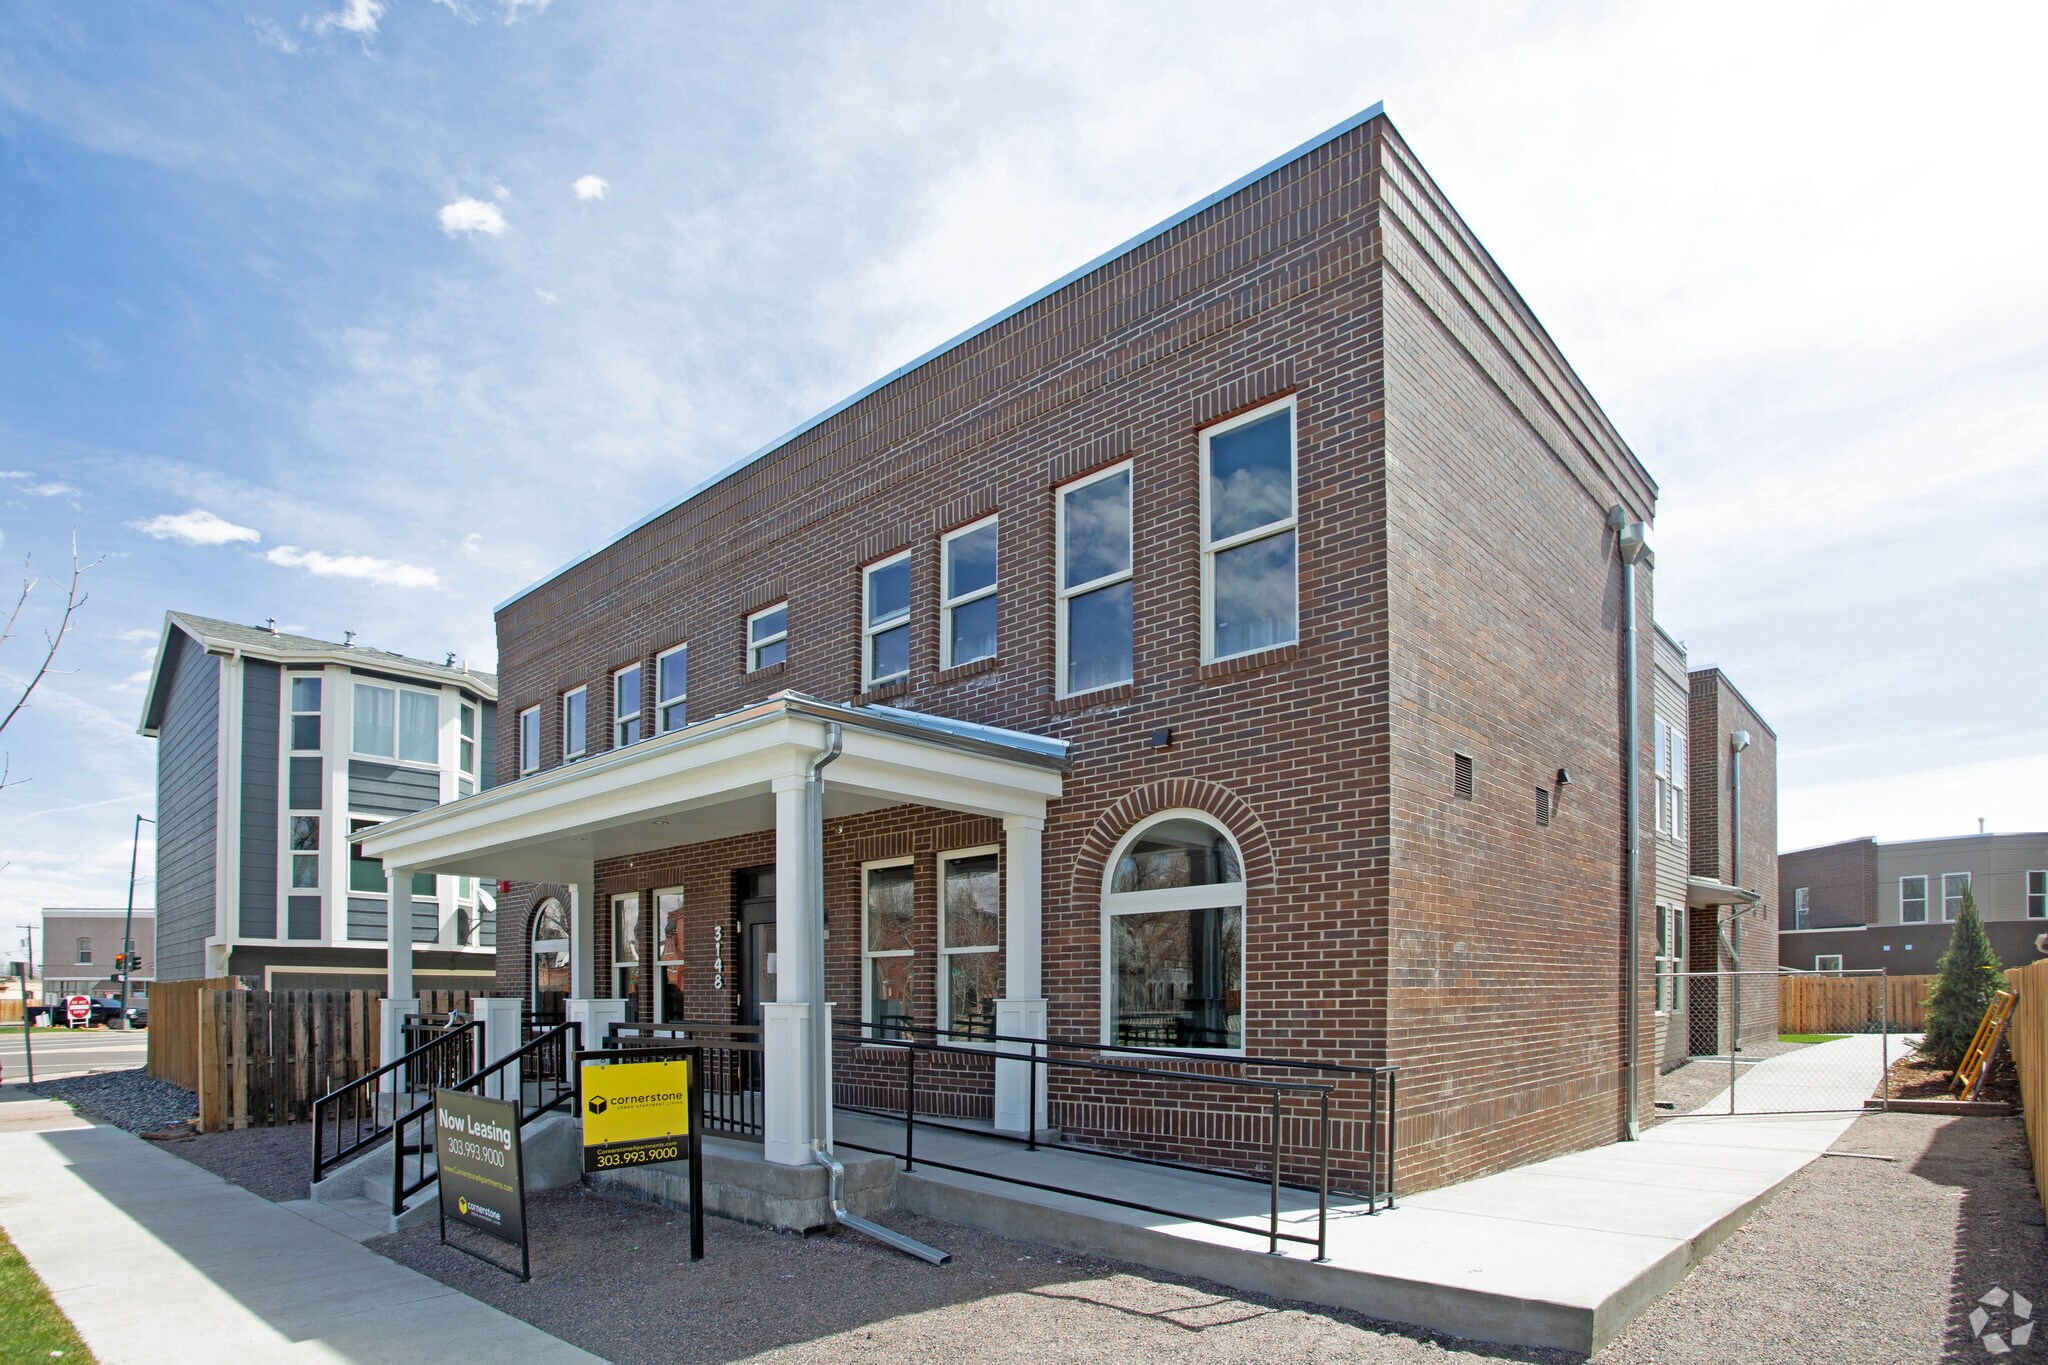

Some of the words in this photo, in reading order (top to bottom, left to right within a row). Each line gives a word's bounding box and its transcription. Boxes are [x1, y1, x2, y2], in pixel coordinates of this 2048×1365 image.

[714, 925, 723, 990] 3148
[610, 1092, 683, 1105] cornerstone
[439, 1108, 464, 1132] Now
[467, 1114, 512, 1150] Leasing
[448, 1136, 505, 1168] 303.993.9000
[597, 1141, 678, 1155] CornerstoneApartments.com
[597, 1147, 678, 1168] 303.993.9000
[444, 1165, 514, 1193] www.CornerstoneApartments.com
[467, 1202, 501, 1220] cornerstone
